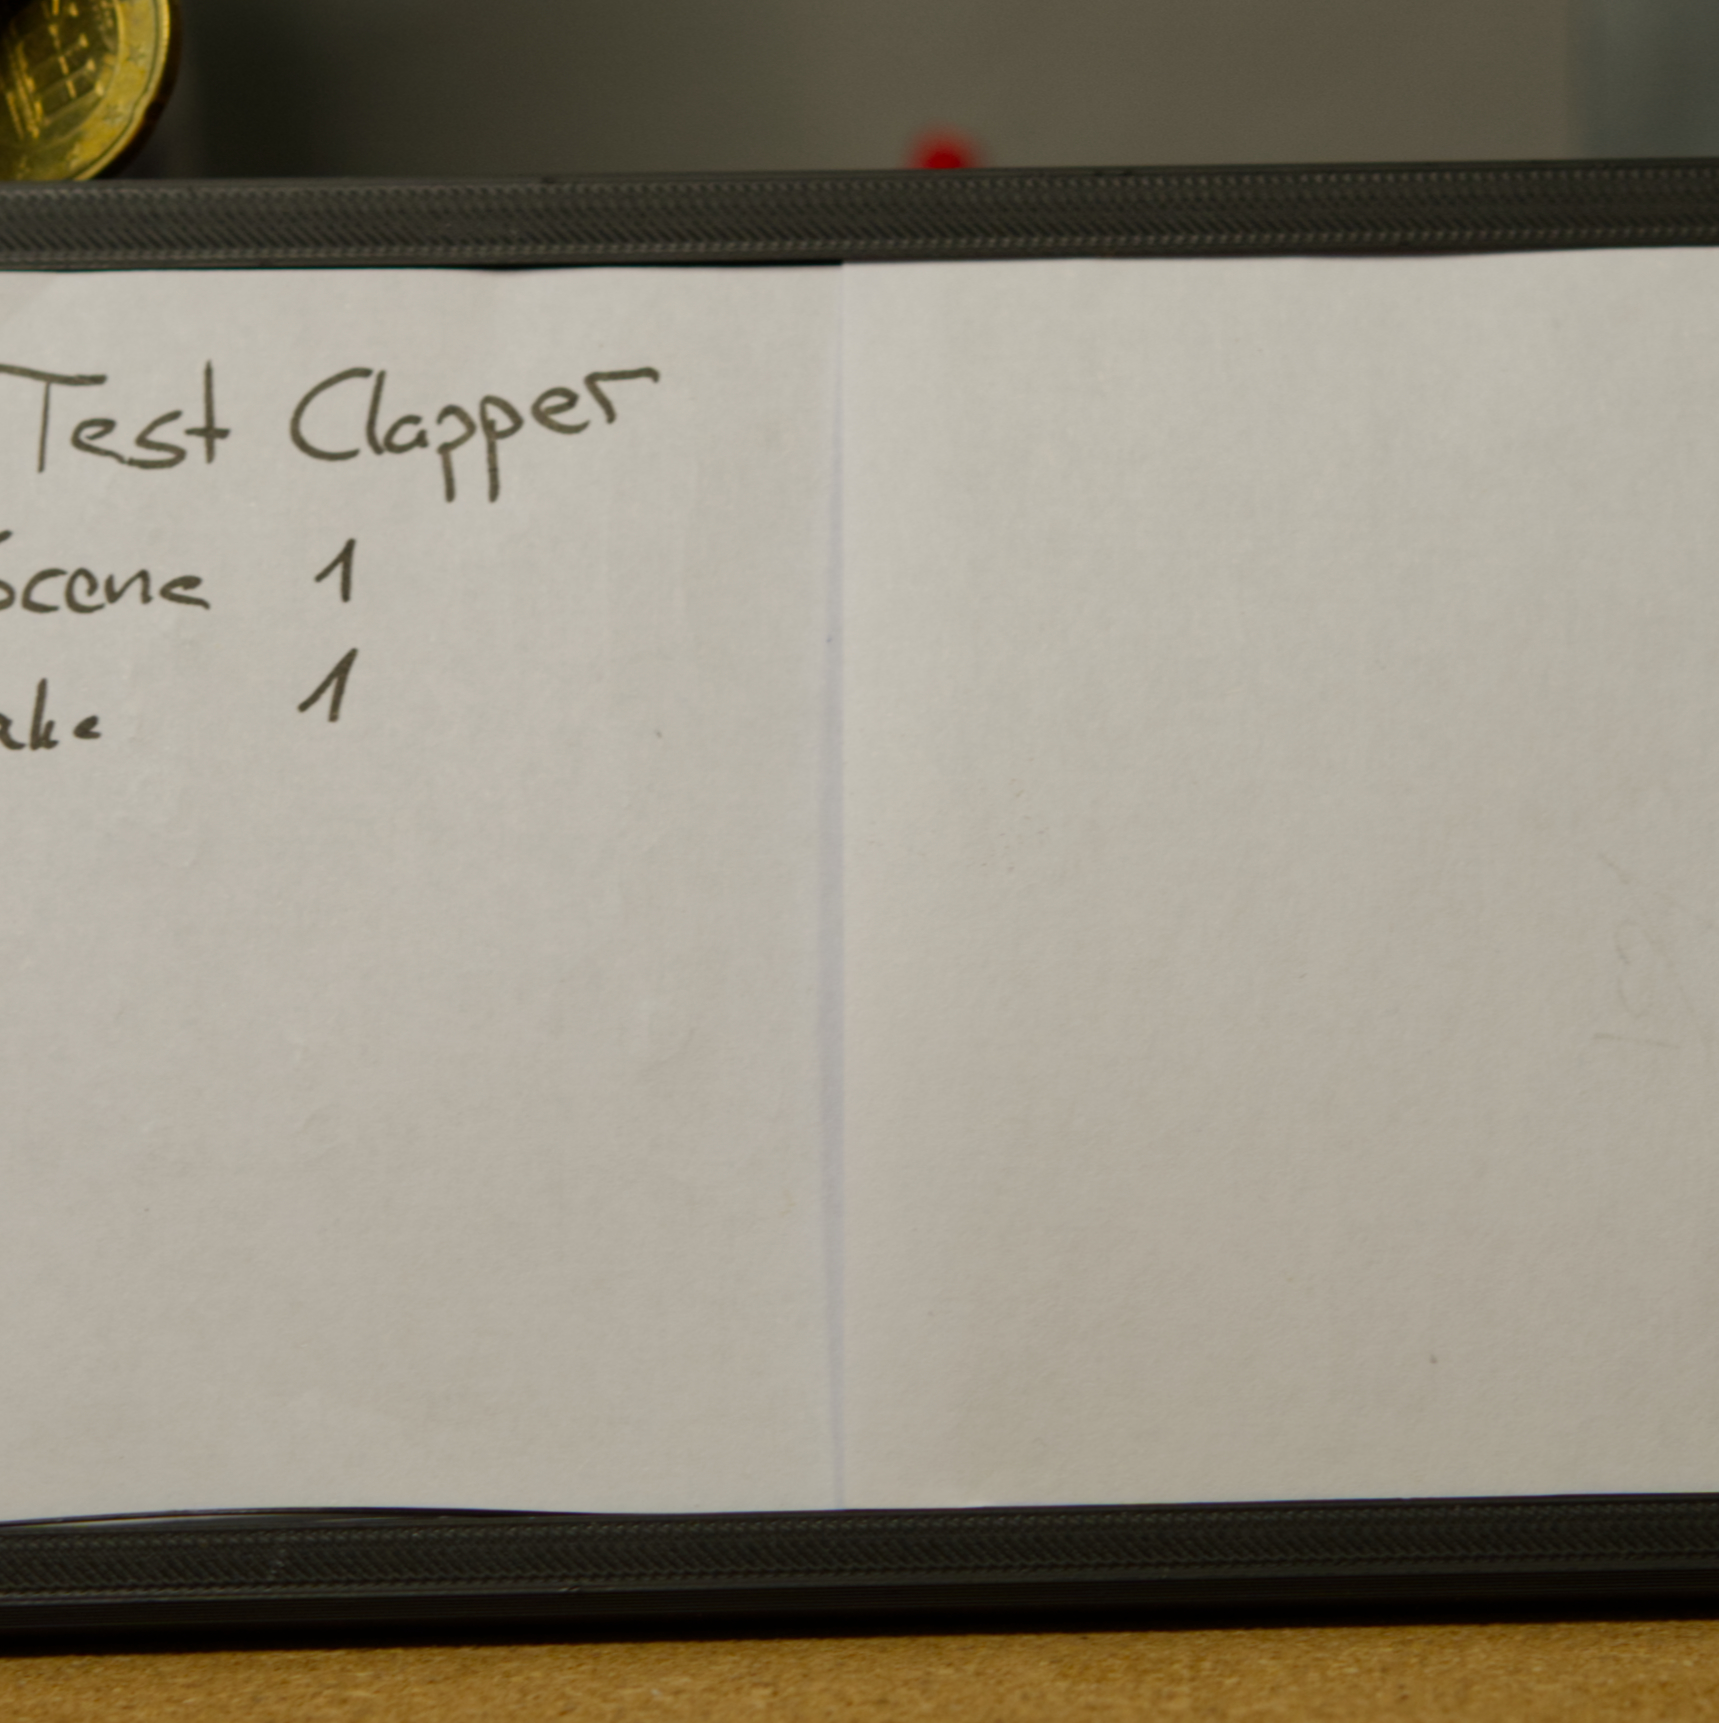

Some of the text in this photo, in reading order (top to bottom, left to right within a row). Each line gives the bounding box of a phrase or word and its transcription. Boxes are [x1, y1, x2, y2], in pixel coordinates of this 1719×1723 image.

[289, 366, 661, 504] Clapper
[314, 537, 357, 604] 1
[296, 646, 359, 724] 1
